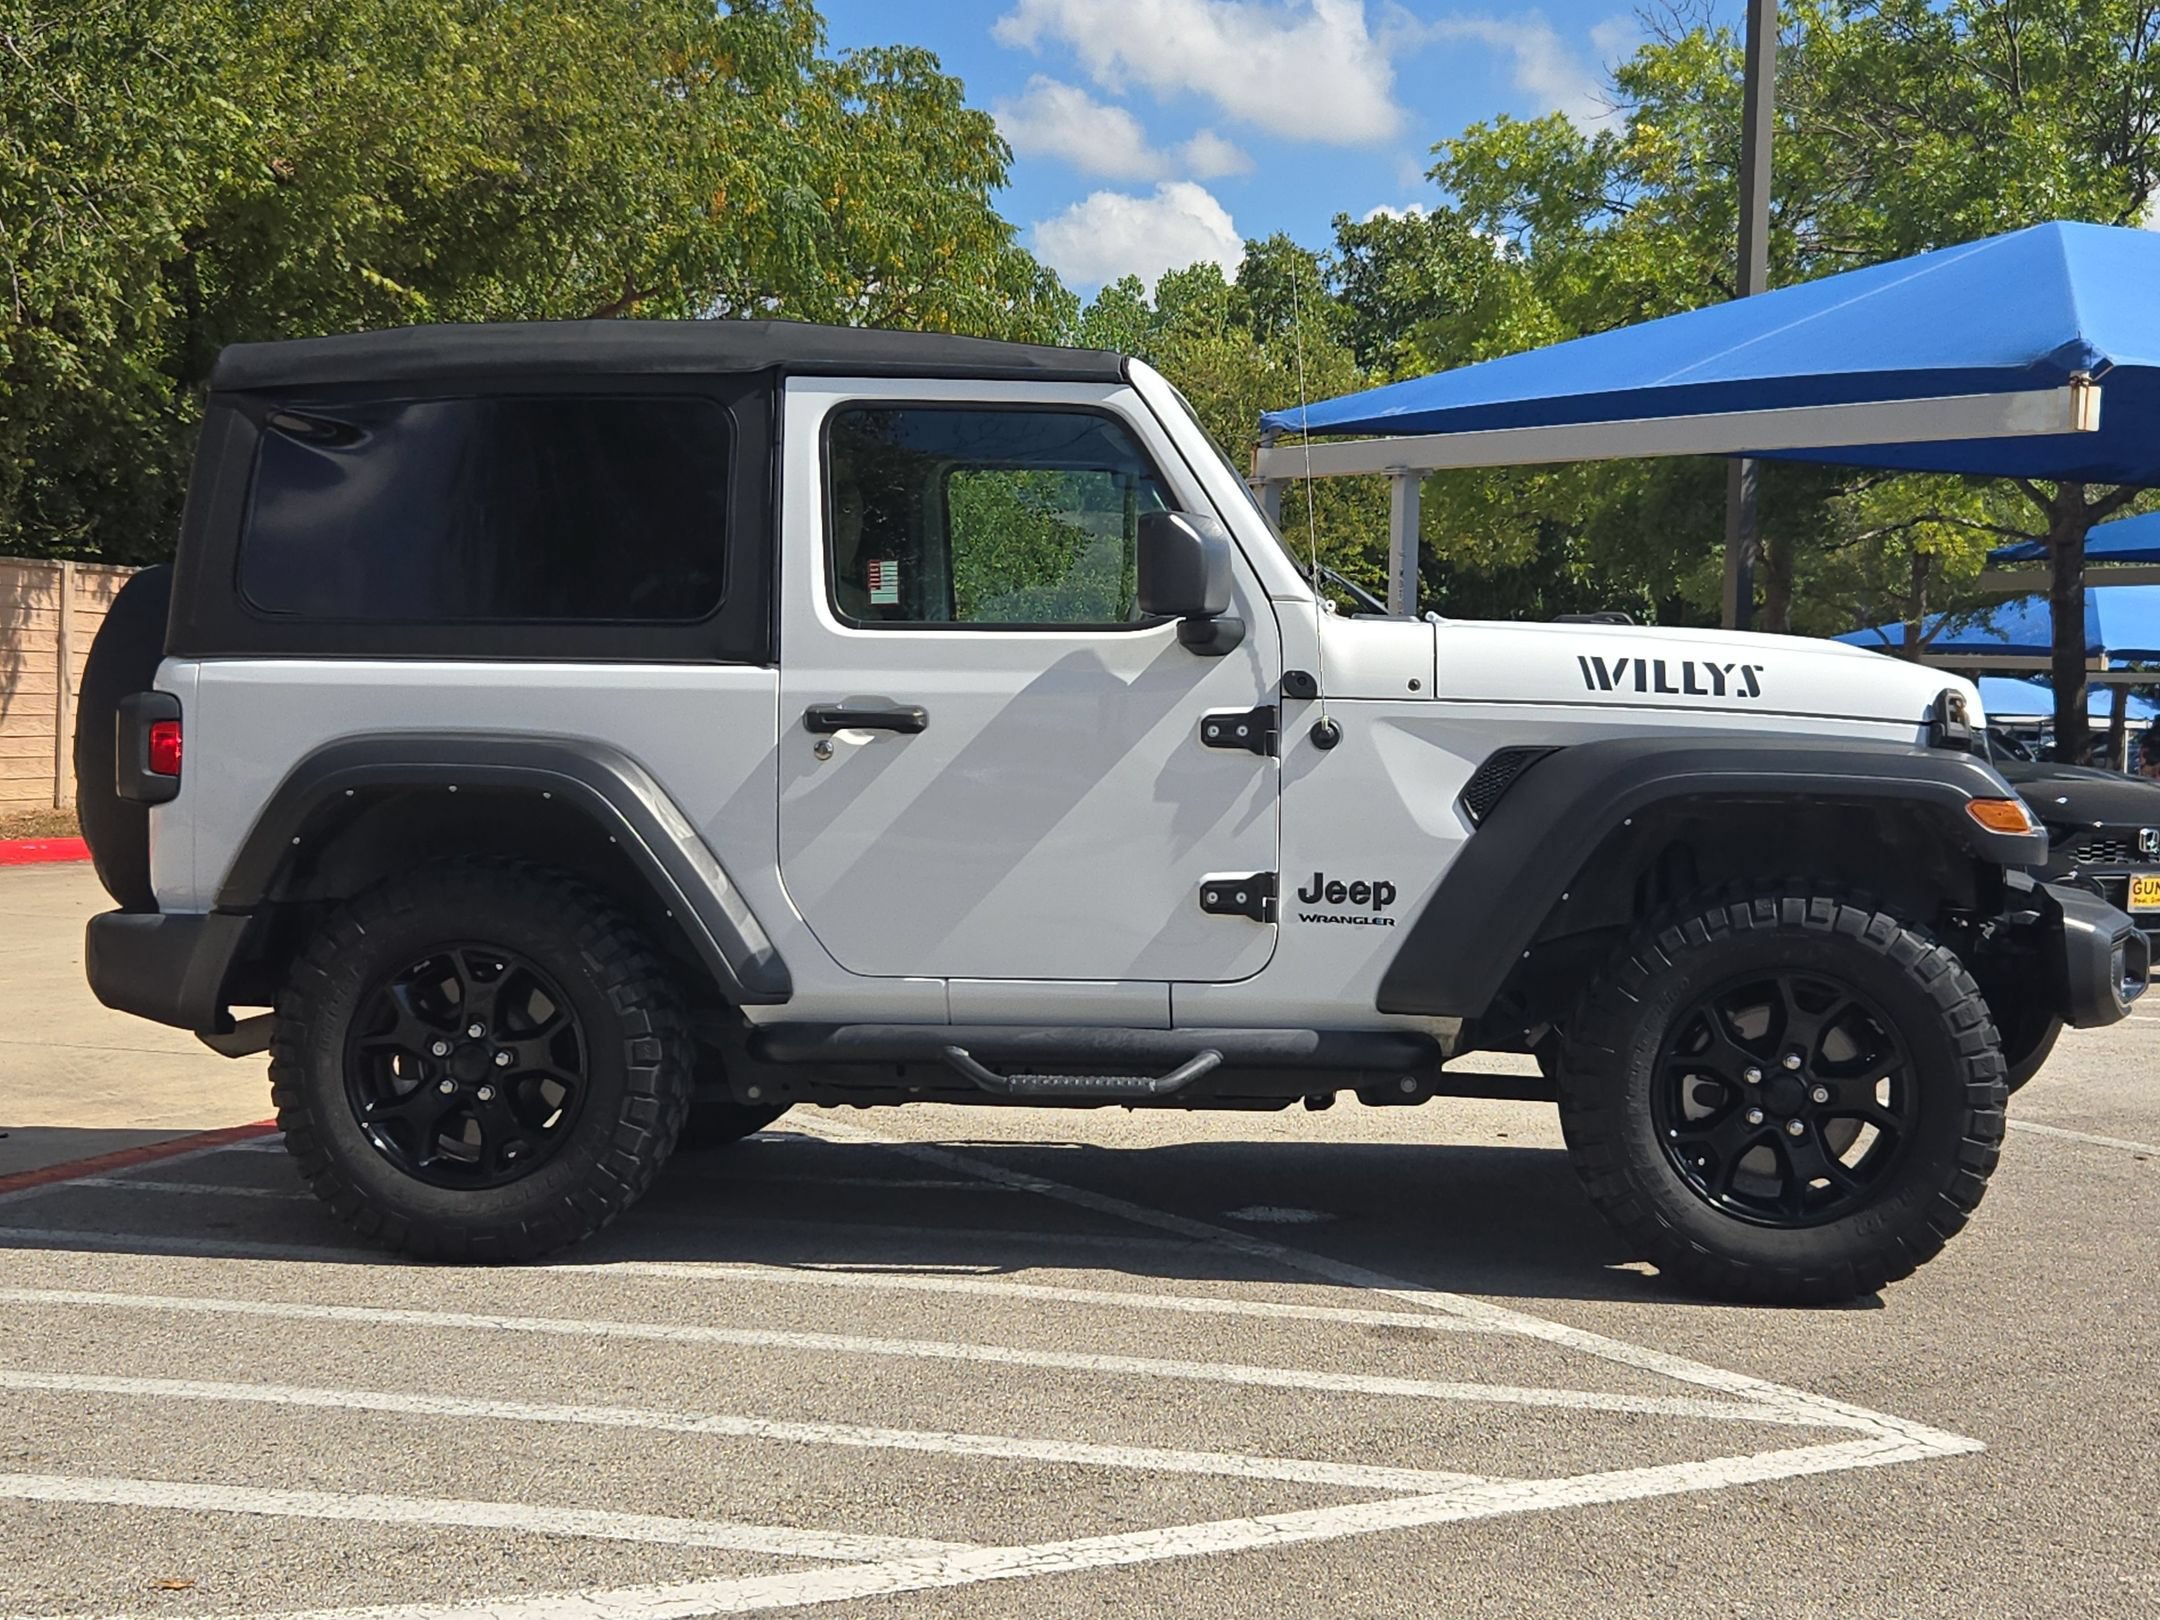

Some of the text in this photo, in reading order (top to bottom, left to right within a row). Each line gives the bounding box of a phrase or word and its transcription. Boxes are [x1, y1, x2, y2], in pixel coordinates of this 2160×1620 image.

[1577, 655, 1764, 698] WILLYS
[1298, 872, 1397, 911] Jeep
[1298, 913, 1396, 927] WRANGLER
